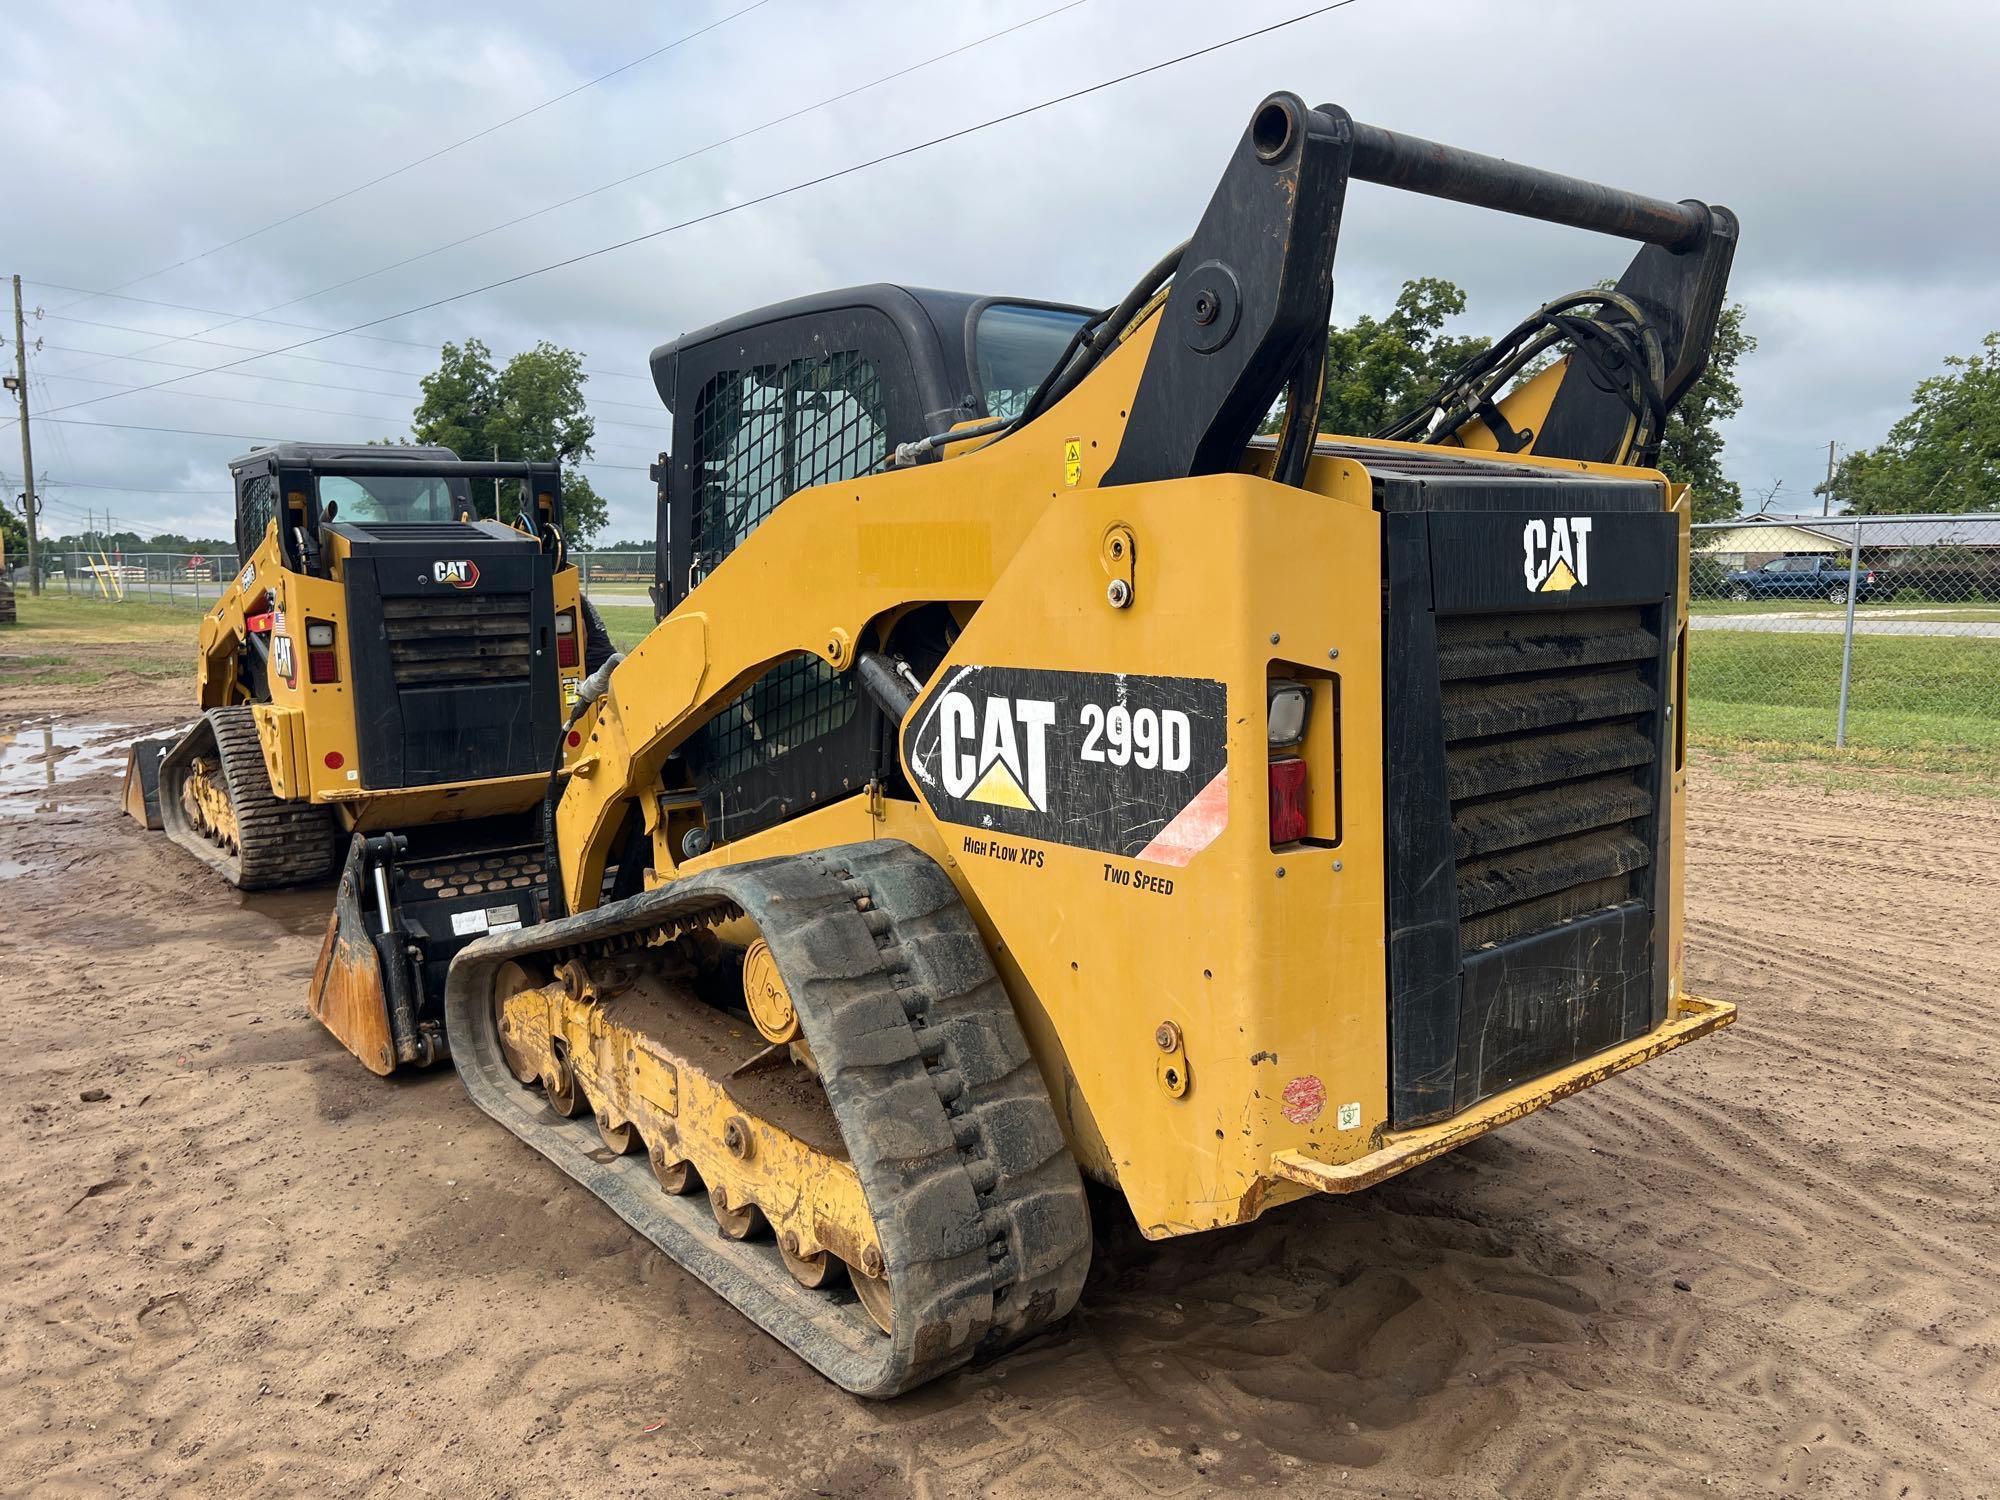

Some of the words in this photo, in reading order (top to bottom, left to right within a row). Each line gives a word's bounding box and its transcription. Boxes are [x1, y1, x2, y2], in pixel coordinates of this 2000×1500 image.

[434, 561, 468, 582] CAT
[1523, 516, 1592, 592] CAT
[274, 636, 292, 677] CAT
[939, 691, 1056, 813] CAT
[1080, 703, 1191, 772] 299D
[1020, 847, 1045, 868] XPS
